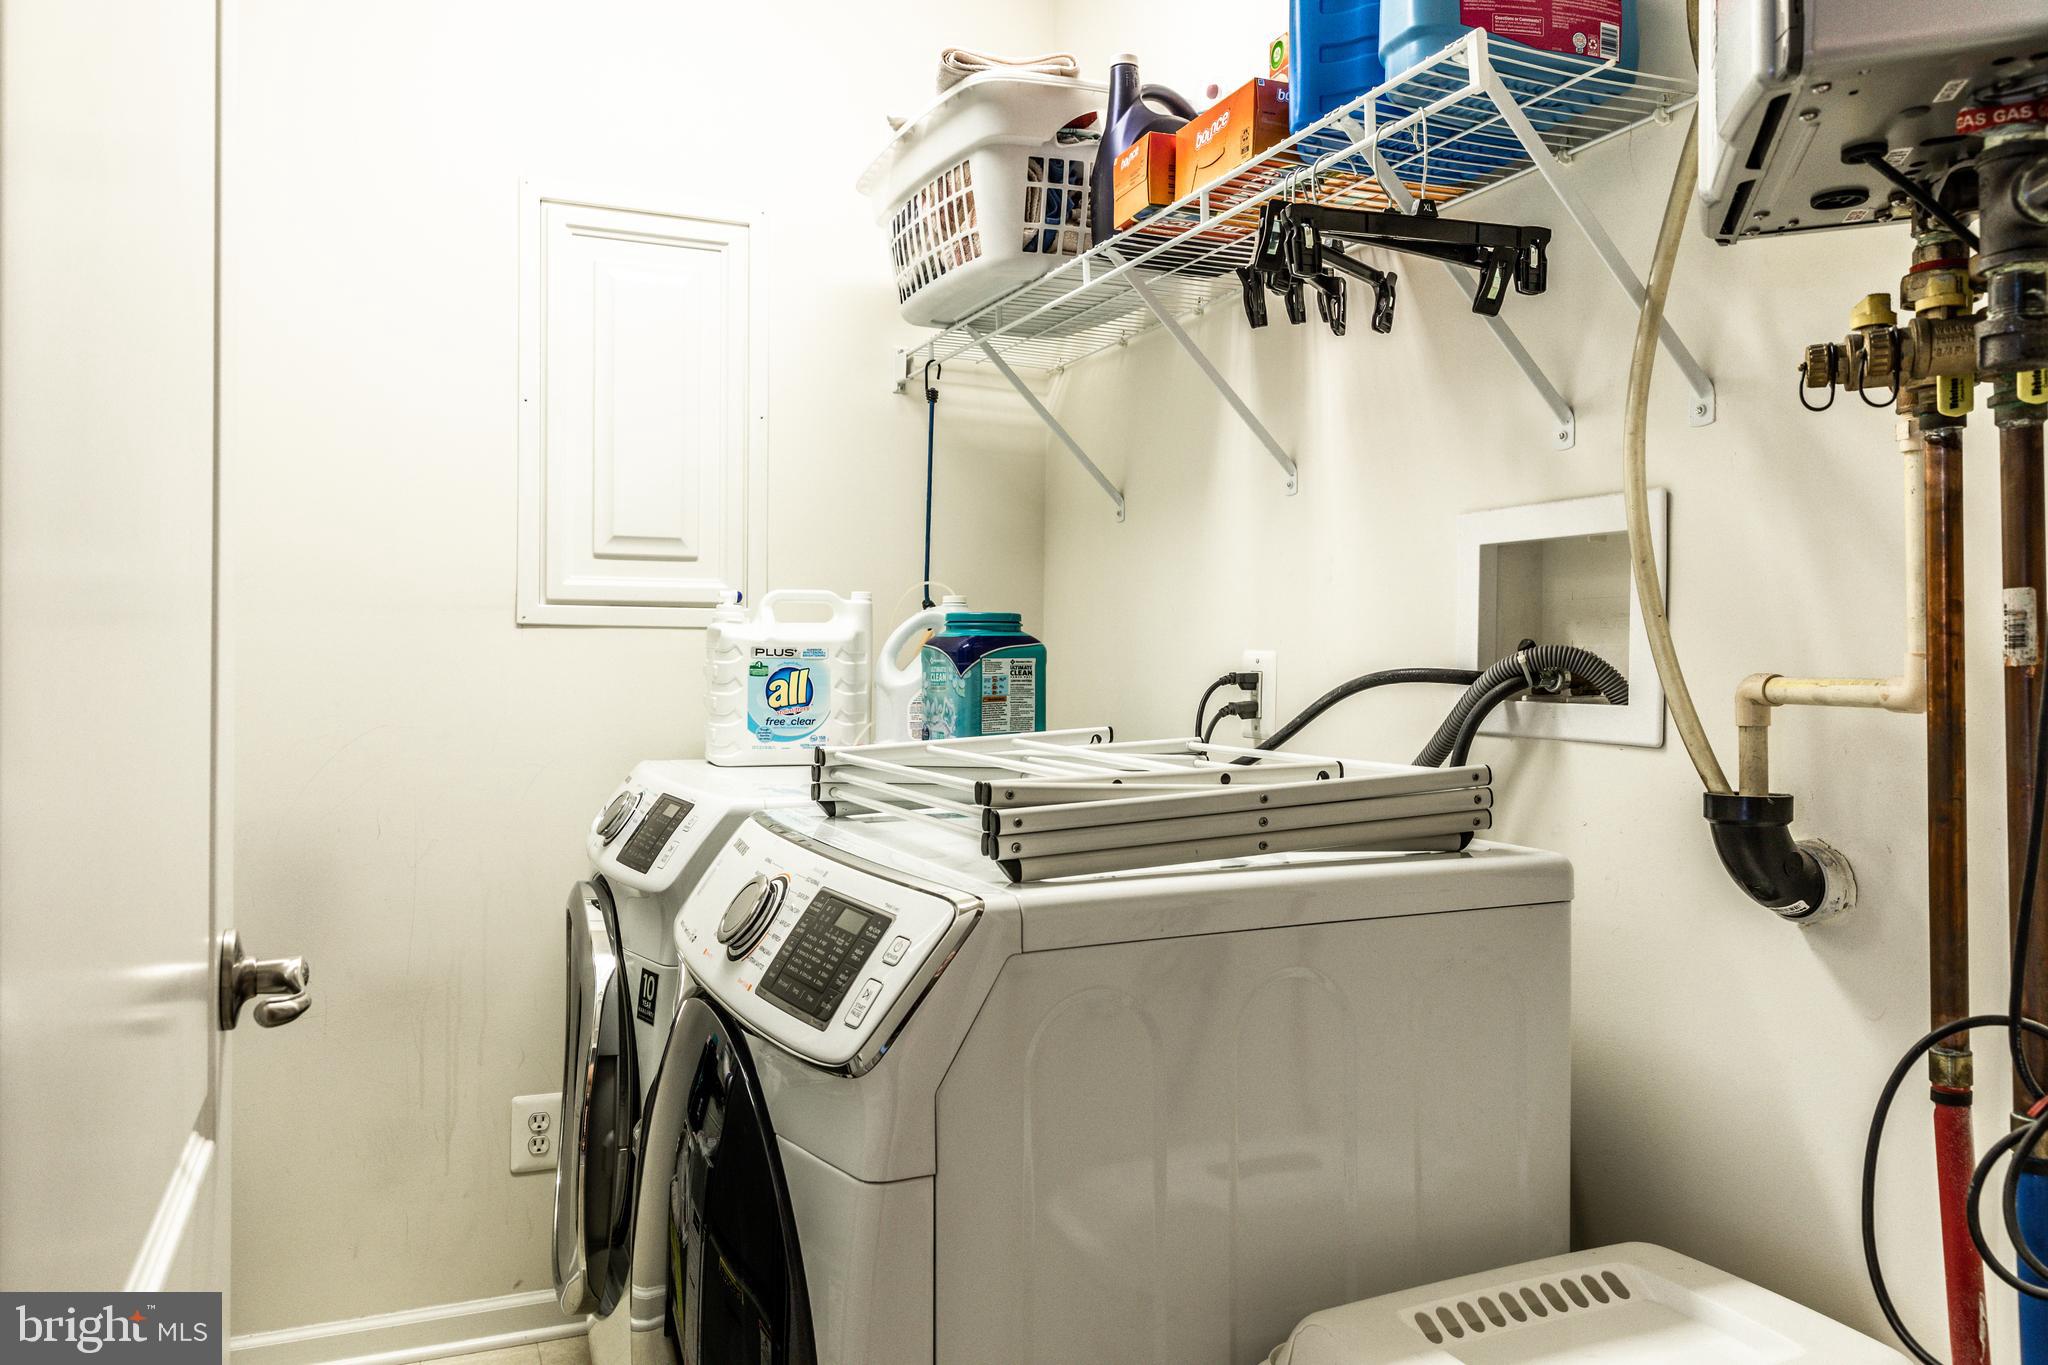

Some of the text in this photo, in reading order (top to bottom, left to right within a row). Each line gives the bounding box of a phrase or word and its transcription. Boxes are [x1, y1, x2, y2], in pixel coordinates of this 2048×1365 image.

[1956, 112, 1986, 129] GAS
[1993, 105, 2032, 123] GAS
[1195, 110, 1230, 151] bounce
[1120, 145, 1139, 170] bounce
[768, 668, 809, 709] all
[930, 673, 946, 682] CLEAN
[766, 717, 816, 726] free clear
[643, 973, 655, 1001] 10
